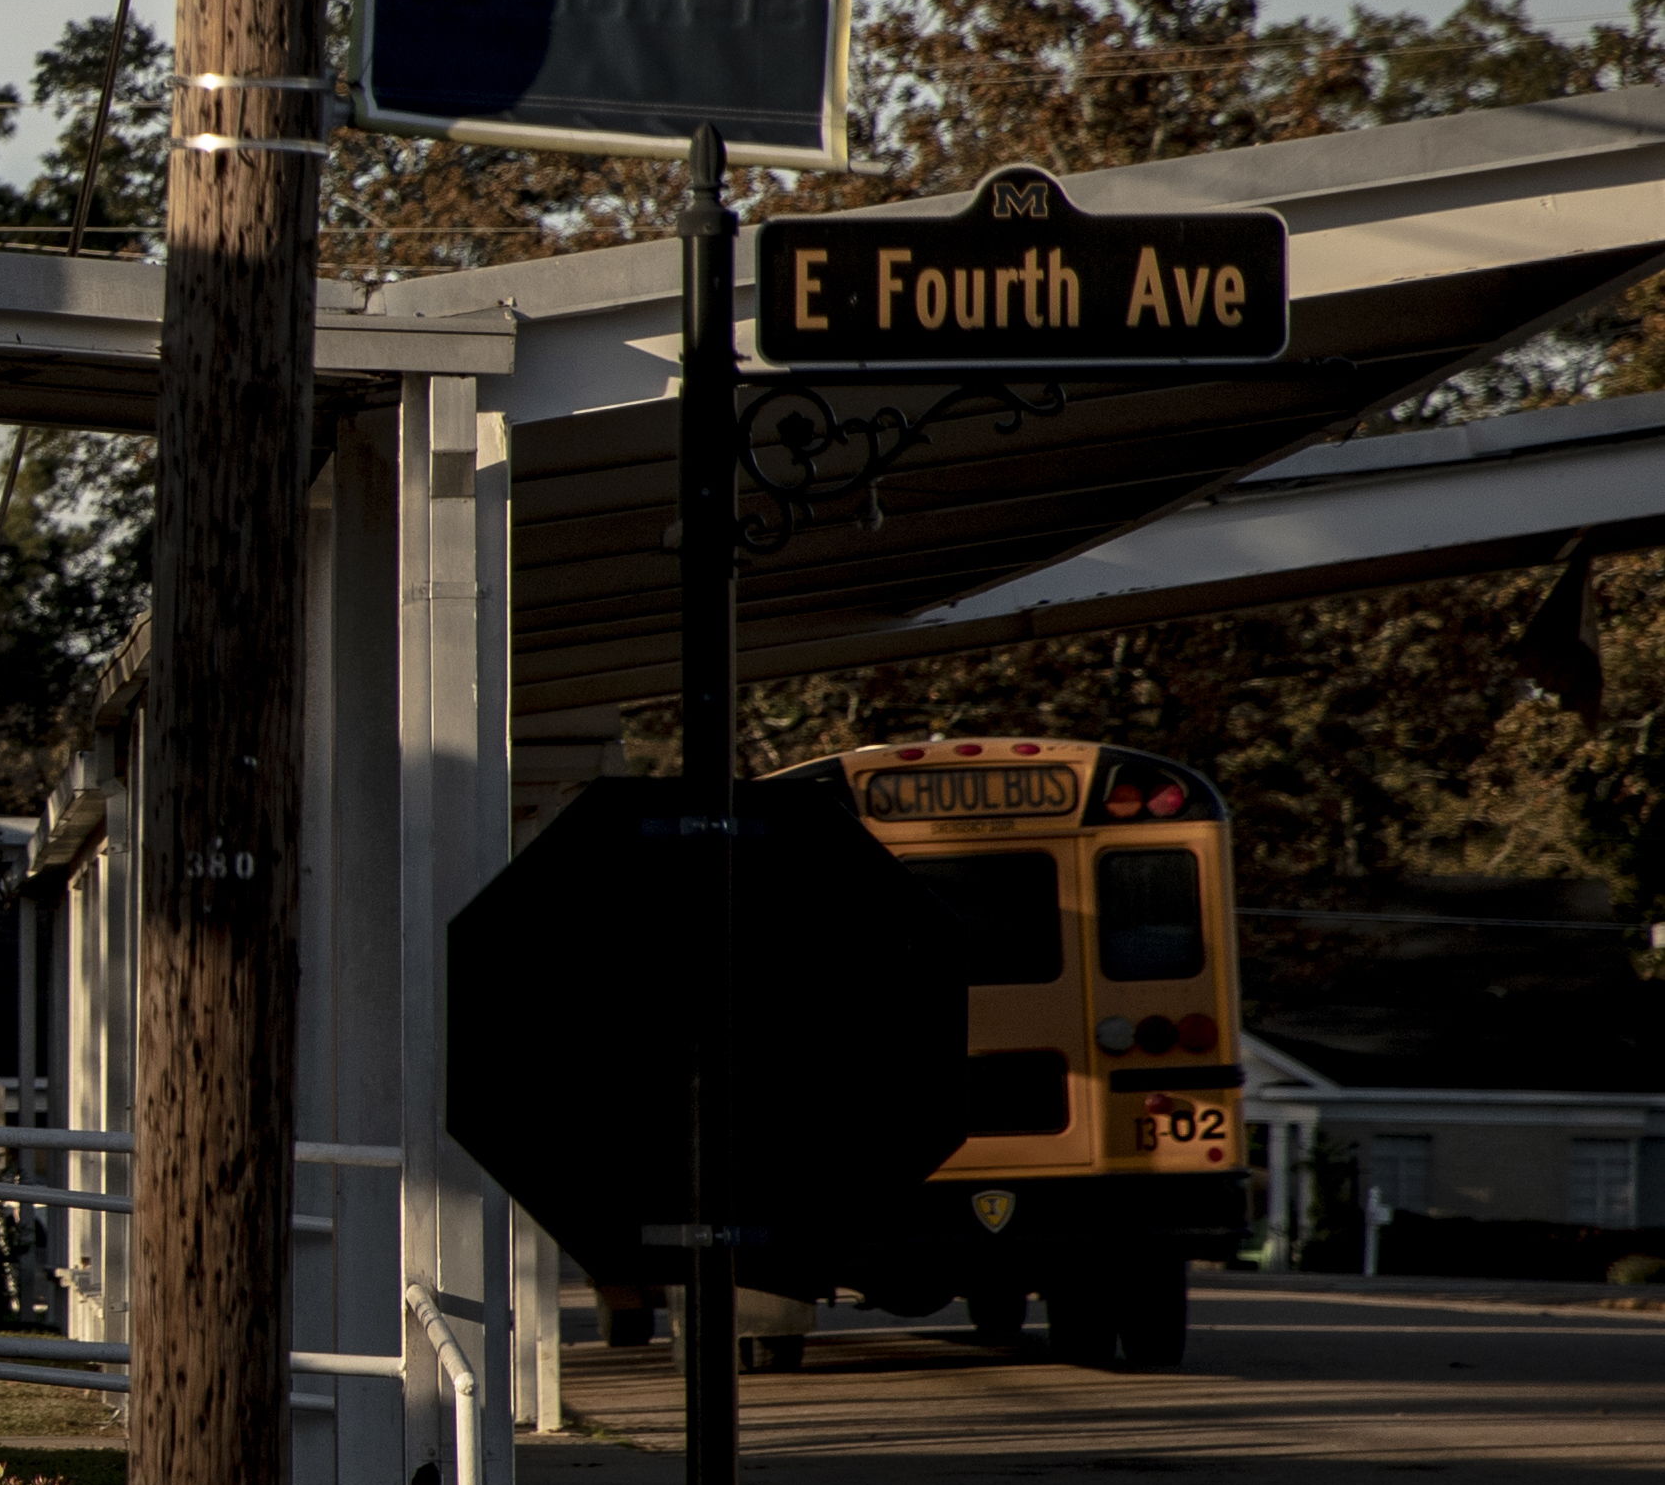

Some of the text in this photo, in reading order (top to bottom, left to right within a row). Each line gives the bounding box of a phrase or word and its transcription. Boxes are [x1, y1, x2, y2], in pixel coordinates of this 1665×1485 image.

[795, 245, 1247, 330] E Fourth Ave
[872, 768, 1066, 815] SCHOOL BUS
